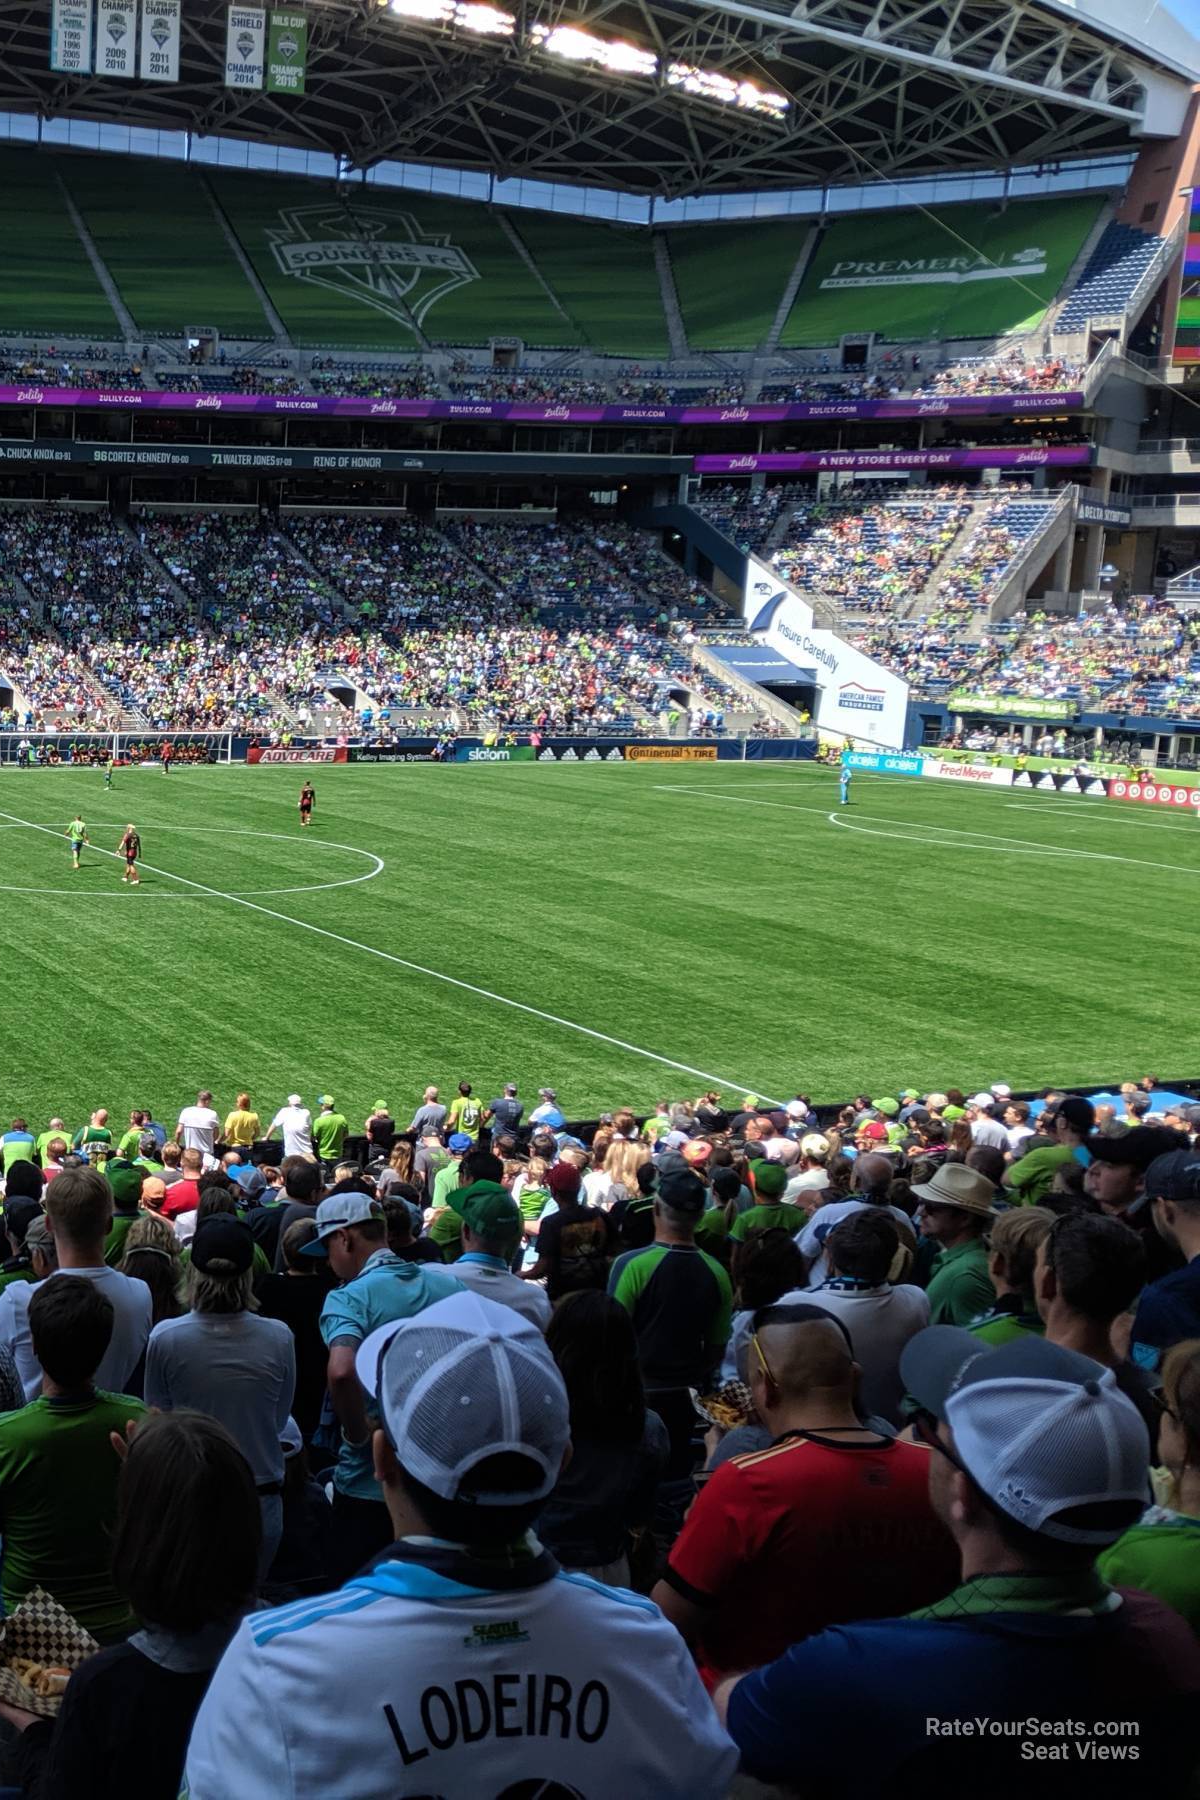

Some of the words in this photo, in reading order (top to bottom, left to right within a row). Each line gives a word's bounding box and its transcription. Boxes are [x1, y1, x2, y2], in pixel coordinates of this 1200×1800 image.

[101, 2, 134, 13] CHAMPS
[145, 6, 178, 17] CHAMPS
[231, 17, 263, 30] SHIELD
[272, 15, 289, 27] MLS
[290, 16, 307, 28] CUP
[63, 30, 81, 40] 1995
[63, 40, 81, 49] 1996
[63, 49, 81, 59] 2005
[105, 47, 127, 59] 2009
[149, 52, 169, 63] 2011
[63, 59, 81, 68] 2007
[105, 58, 126, 70] 2010
[149, 63, 170, 74] 2014
[227, 62, 263, 75] CHAMPS
[270, 63, 304, 78] CHAMPS
[234, 73, 254, 84] 2014
[275, 75, 298, 88] 2016
[426, 253, 459, 268] FC
[831, 255, 994, 276] PREMERA
[99, 394, 142, 403] ZULILY.COM
[275, 400, 318, 409] ZULILY.COM
[1013, 397, 1067, 407] ZULILY.COM
[449, 405, 492, 414] ZULILY.COM
[622, 409, 666, 418] ZULILY.COM
[808, 406, 857, 415] ZULILY.COM
[6, 448, 32, 460] CHUCK
[33, 449, 55, 460] KNOX
[94, 450, 108, 461] 96
[108, 451, 135, 462] CORTEZ
[137, 452, 171, 463] KENNEDY
[211, 453, 223, 464] 71
[223, 453, 252, 465] WALTER
[252, 455, 276, 466] JONES
[819, 457, 827, 466] A
[830, 457, 855, 465] NEW
[857, 455, 892, 465] STORE
[894, 454, 927, 464] EVERY
[928, 454, 952, 463] DAY
[313, 456, 336, 467] RING
[337, 457, 350, 467] OF
[351, 457, 381, 468] HONOR
[776, 619, 801, 644] Insure
[803, 636, 840, 674] Carefully
[839, 691, 863, 701] AMERICAN
[865, 692, 886, 702] FAMILY
[840, 700, 882, 711] INSURANCE
[260, 749, 336, 762] ADVOCARE
[378, 753, 405, 763] Imaging
[468, 747, 510, 760] slalom
[628, 746, 683, 760] Continental
[939, 763, 961, 776] Fred
[962, 766, 994, 780] Meyer
[383, 1673, 610, 1766] LODEIRO
